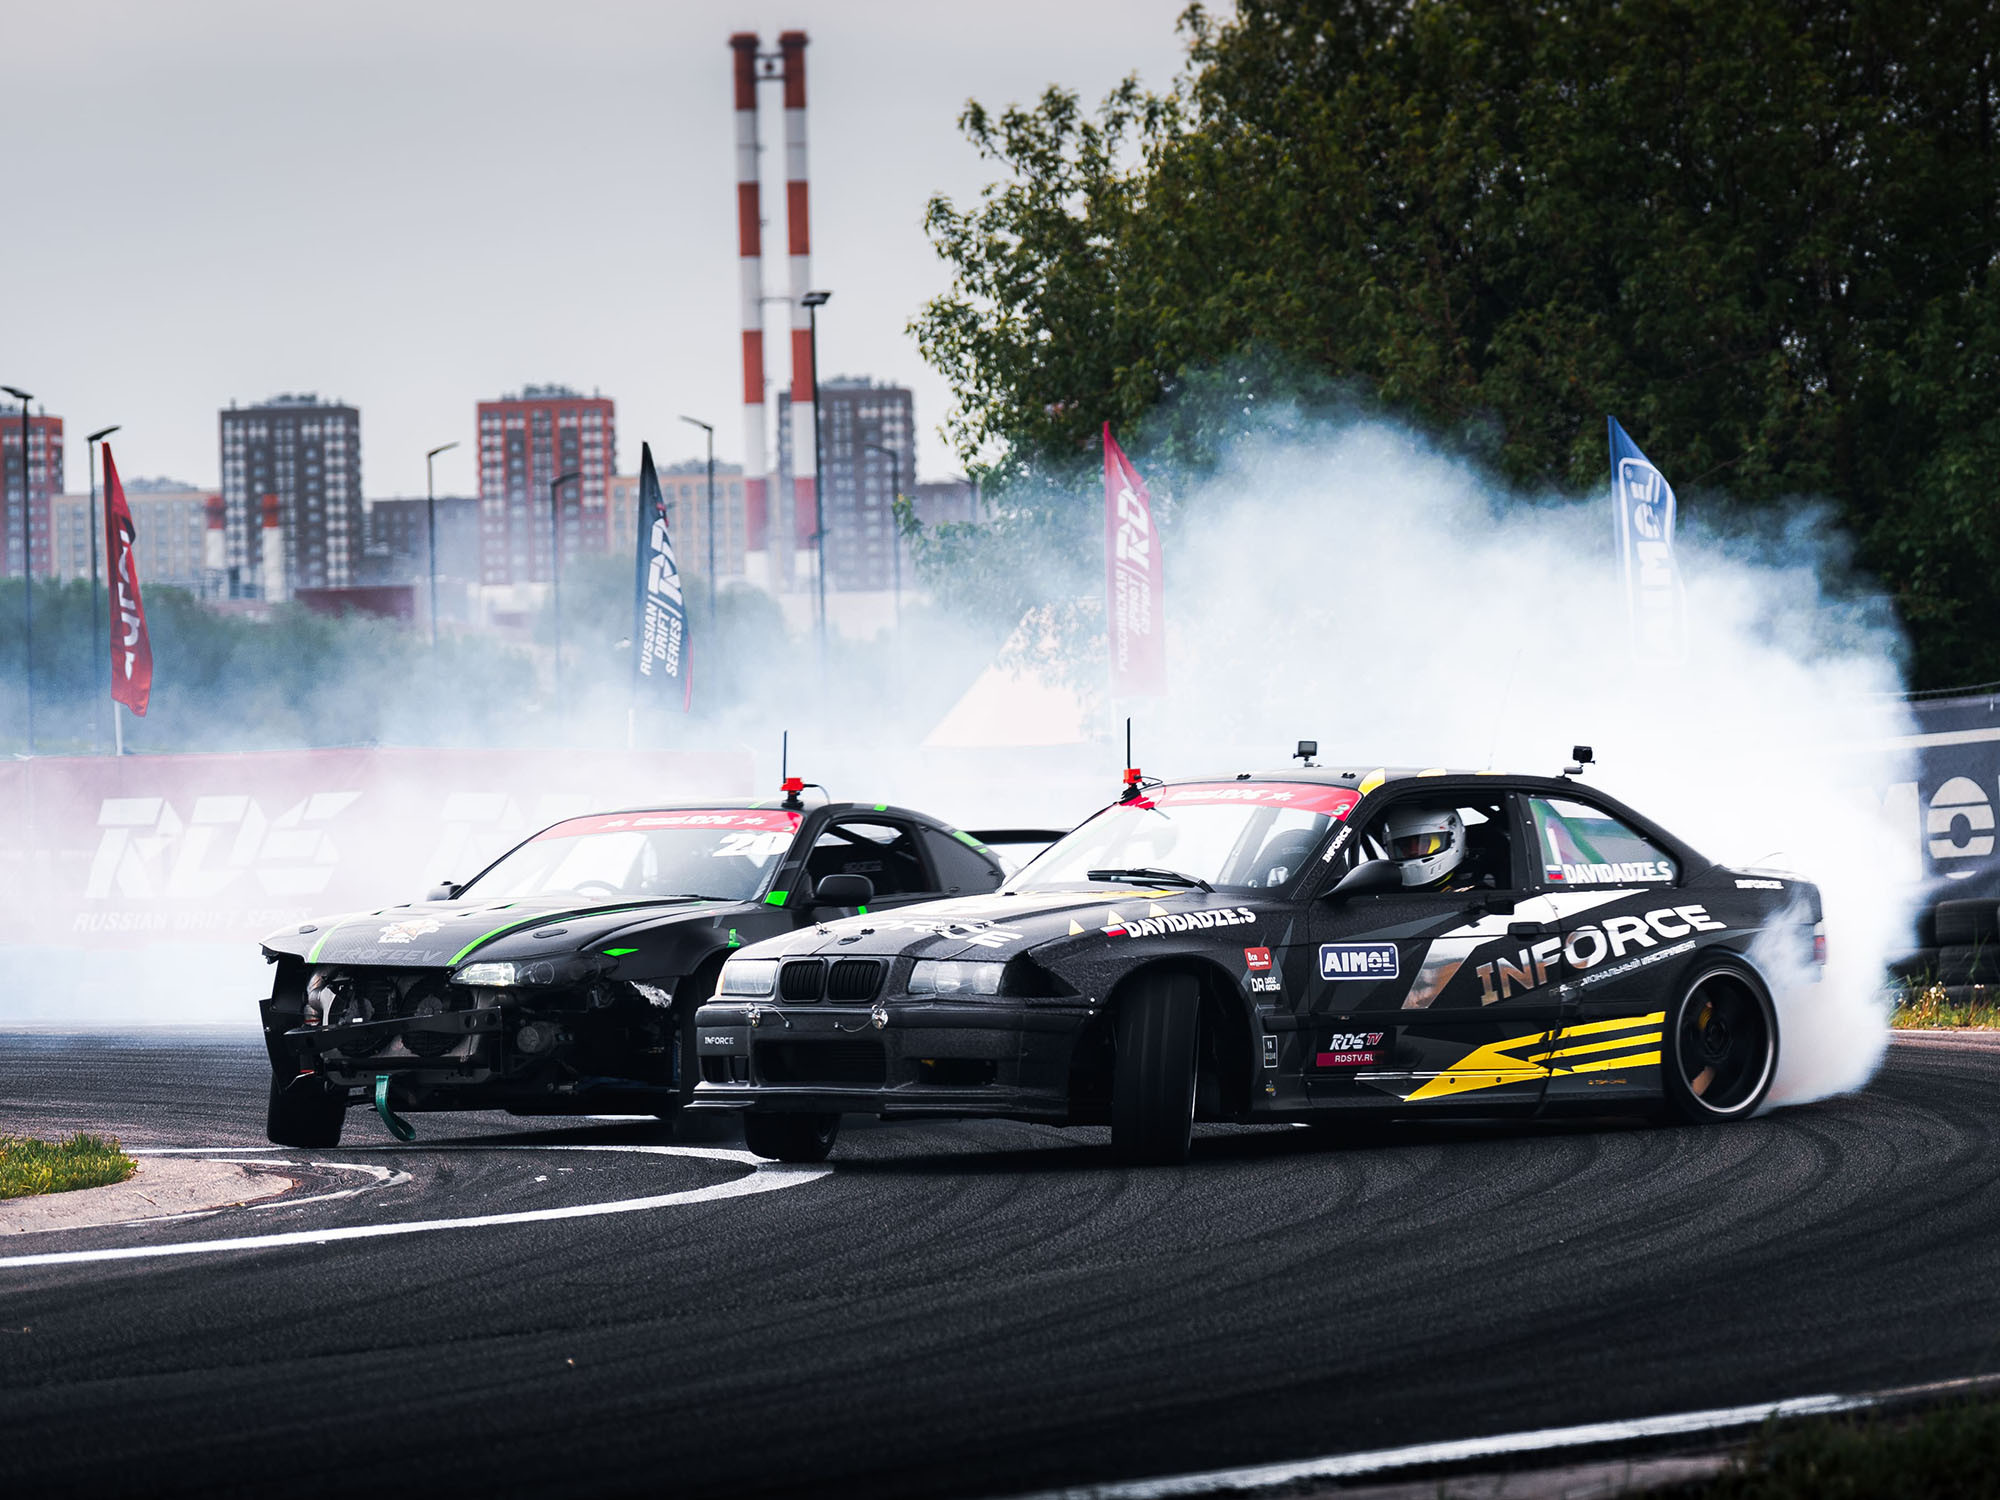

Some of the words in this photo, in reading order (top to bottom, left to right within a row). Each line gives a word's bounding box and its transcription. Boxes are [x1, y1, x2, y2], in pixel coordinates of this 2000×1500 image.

[1116, 486, 1150, 572] RD
[647, 517, 683, 606] RD
[639, 603, 659, 677] RUSSIAN
[653, 606, 672, 661] DRIFT
[665, 615, 684, 680] SERIES
[84, 791, 365, 900] RDS
[1321, 824, 1353, 864] INFORCE
[71, 910, 167, 933] RUSSIAN
[1121, 906, 1257, 939] DAVIDADZE.S
[1324, 951, 1395, 973] AIMOL
[1475, 904, 1728, 1007] INFORCE
[704, 1036, 735, 1045] INFORCE
